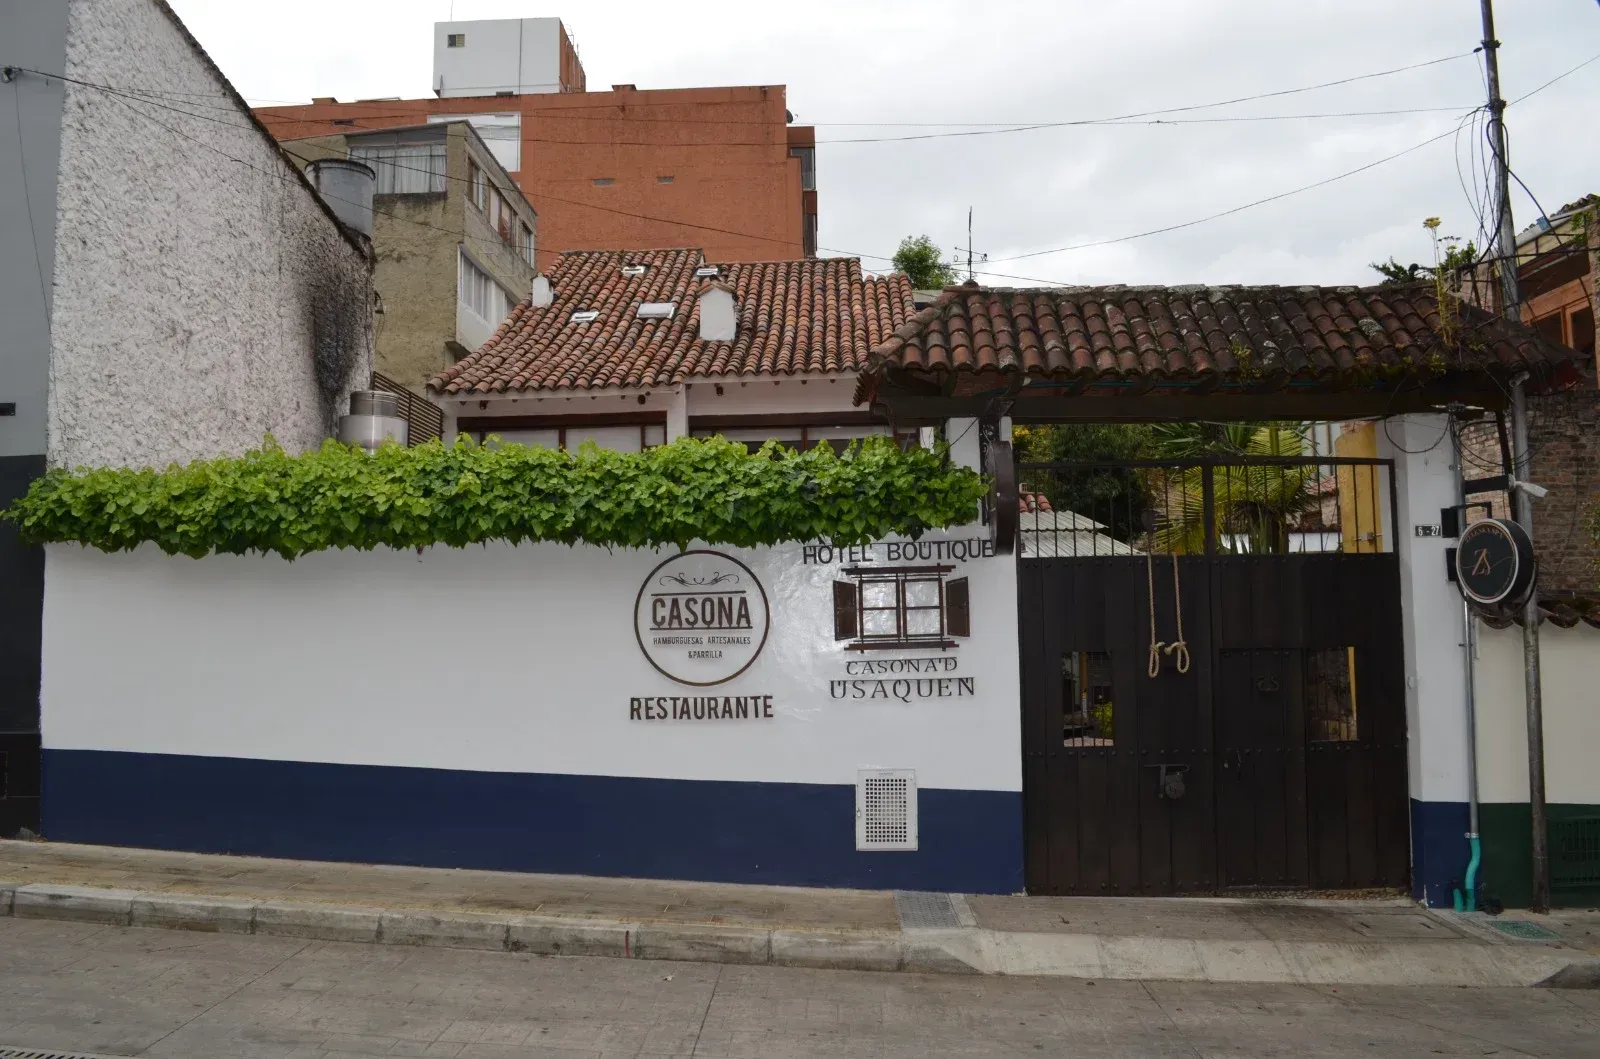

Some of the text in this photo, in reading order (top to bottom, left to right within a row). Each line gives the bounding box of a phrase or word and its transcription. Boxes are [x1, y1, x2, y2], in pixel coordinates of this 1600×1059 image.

[887, 540, 995, 562] BOUTIQUE
[652, 596, 751, 628] CASONA
[653, 636, 752, 645] HAMBURGUESAS ARTESANALES
[830, 677, 975, 703] USAQUEN
[630, 695, 774, 720] RESTAURANTE
